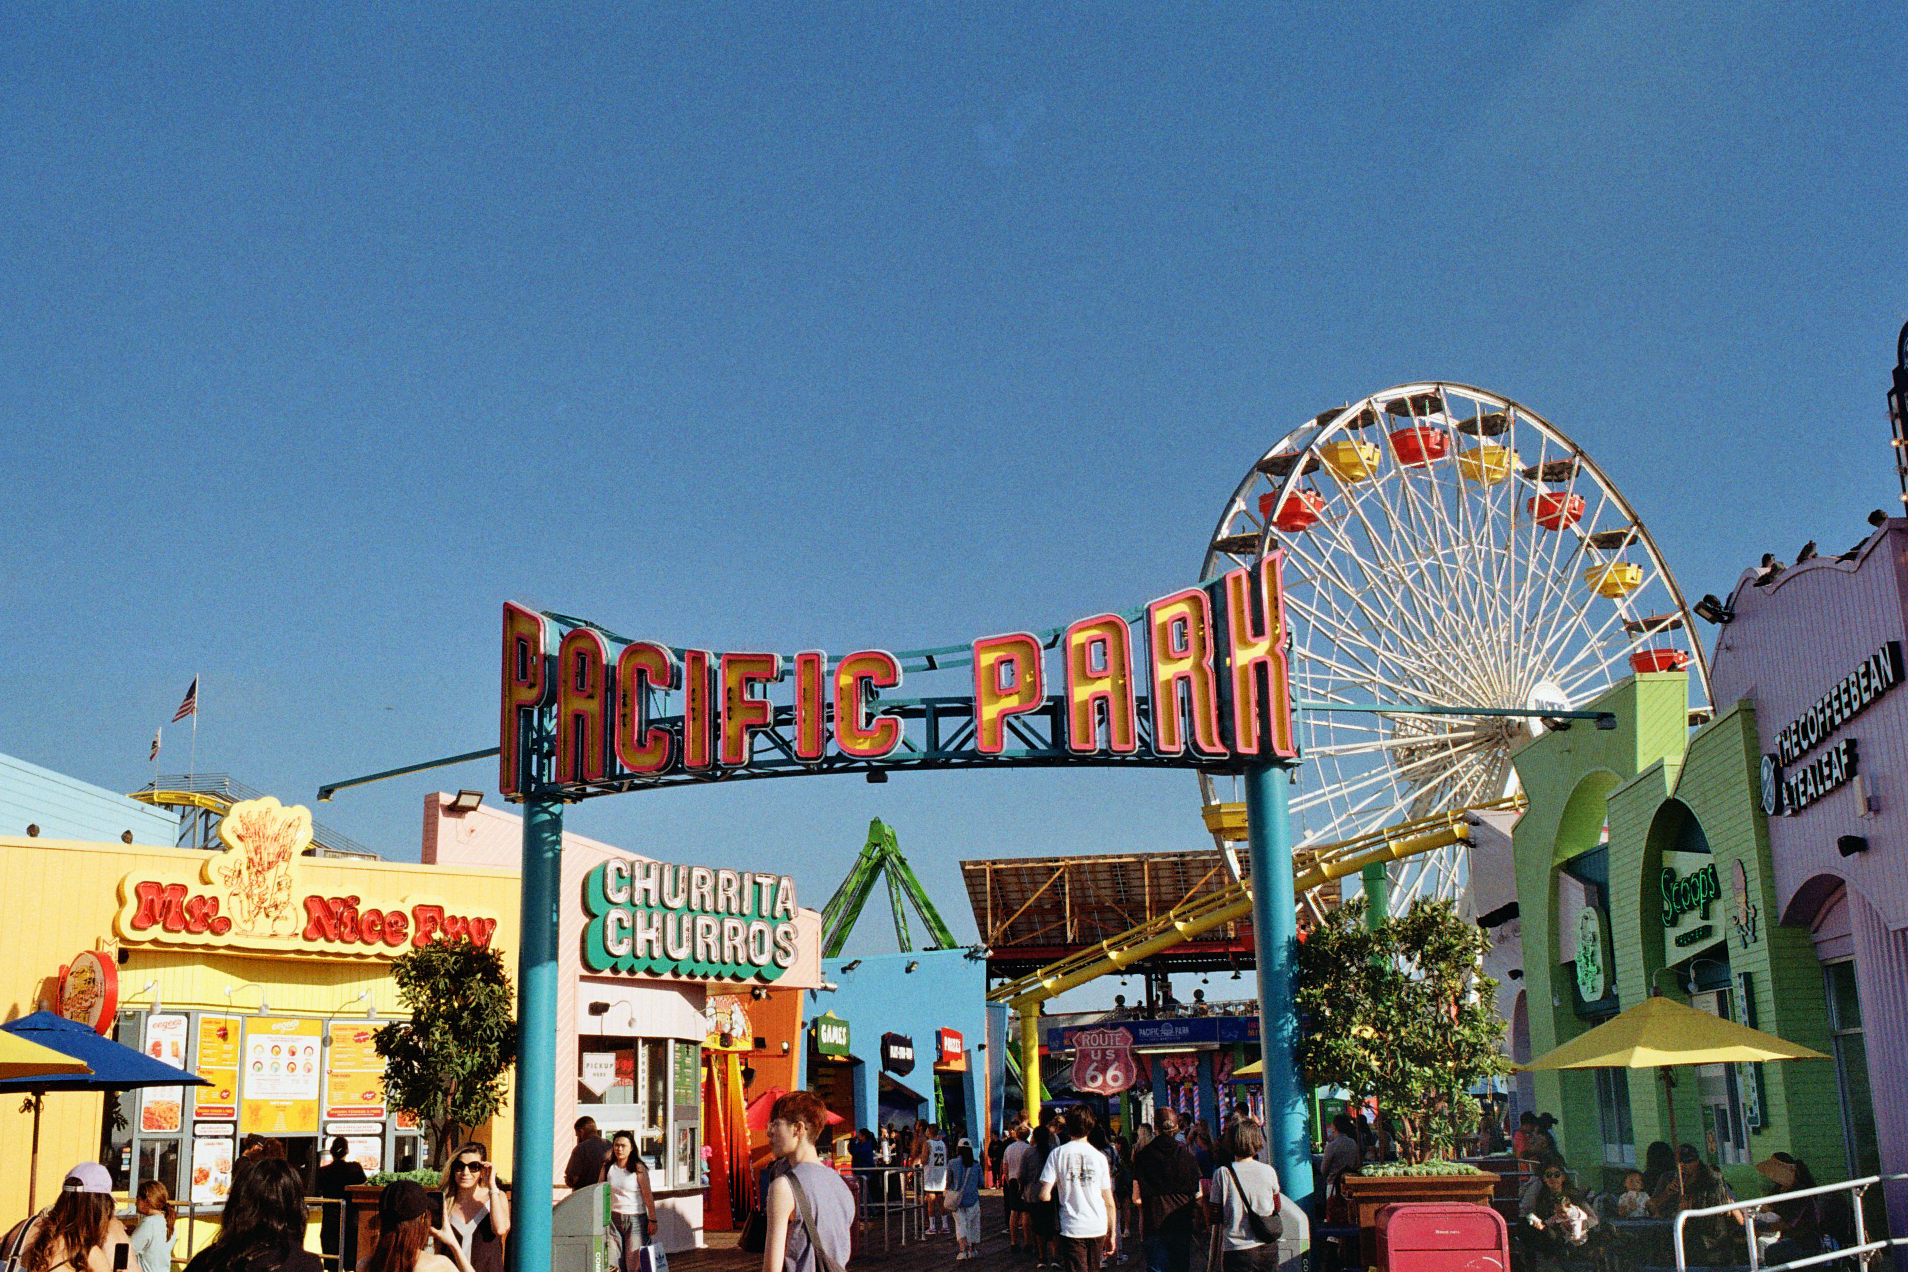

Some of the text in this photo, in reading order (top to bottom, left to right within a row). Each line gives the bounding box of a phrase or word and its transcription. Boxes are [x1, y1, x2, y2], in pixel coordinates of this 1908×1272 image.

[500, 548, 1298, 796] PACIFIC PARK
[602, 857, 799, 920] CHURRITA
[1661, 863, 1719, 927] Scoops
[129, 880, 232, 936] Mr.
[300, 894, 409, 947] Nice
[602, 907, 799, 969] CHURROS
[821, 1024, 847, 1046] GAMES
[1082, 1033, 1122, 1046] ROUTE
[586, 1062, 614, 1070] PICKUP
[1085, 1061, 1125, 1088] 66
[934, 1153, 944, 1167] 23
